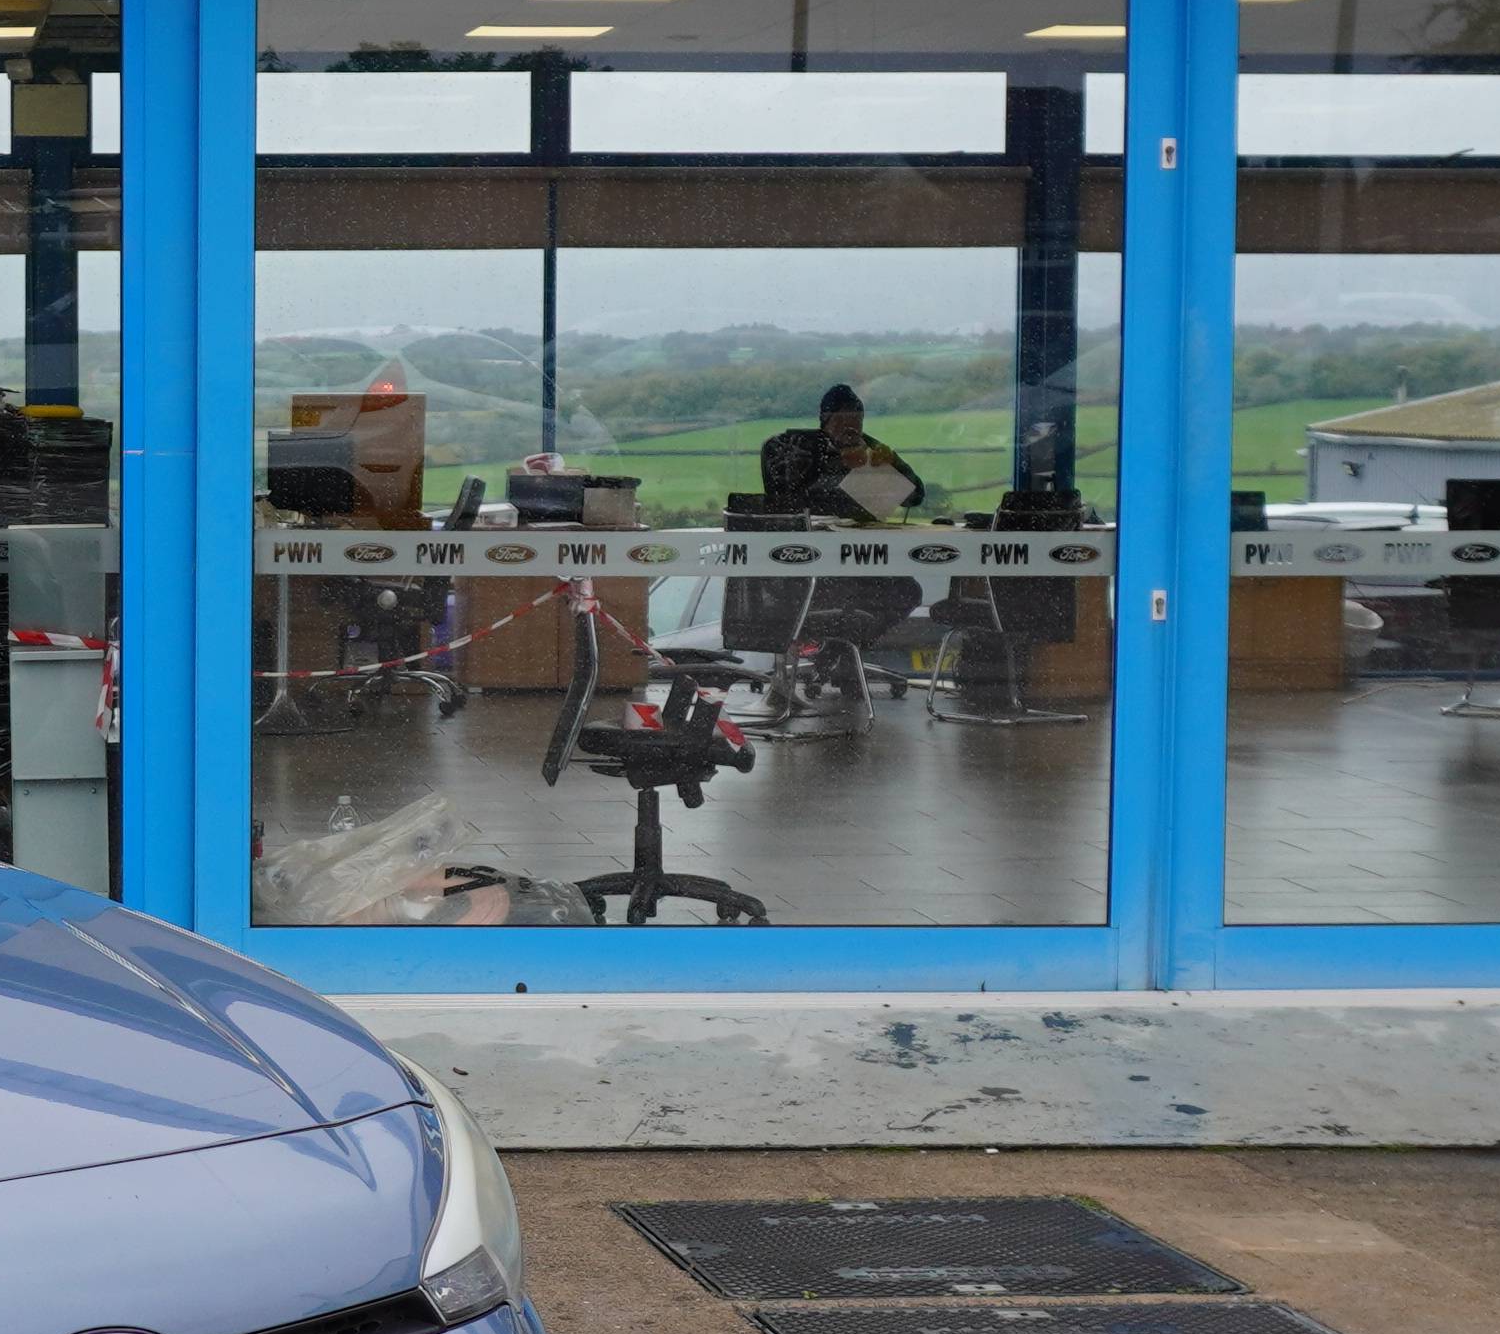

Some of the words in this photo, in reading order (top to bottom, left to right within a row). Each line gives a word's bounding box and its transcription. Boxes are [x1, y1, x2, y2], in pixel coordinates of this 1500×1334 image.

[273, 542, 323, 564] PWM
[351, 545, 388, 561] Ford
[415, 542, 465, 565] PWM
[557, 543, 607, 565] PWM
[839, 543, 889, 565] PWM
[980, 543, 1029, 565] PWM
[1458, 545, 1495, 561] Ford
